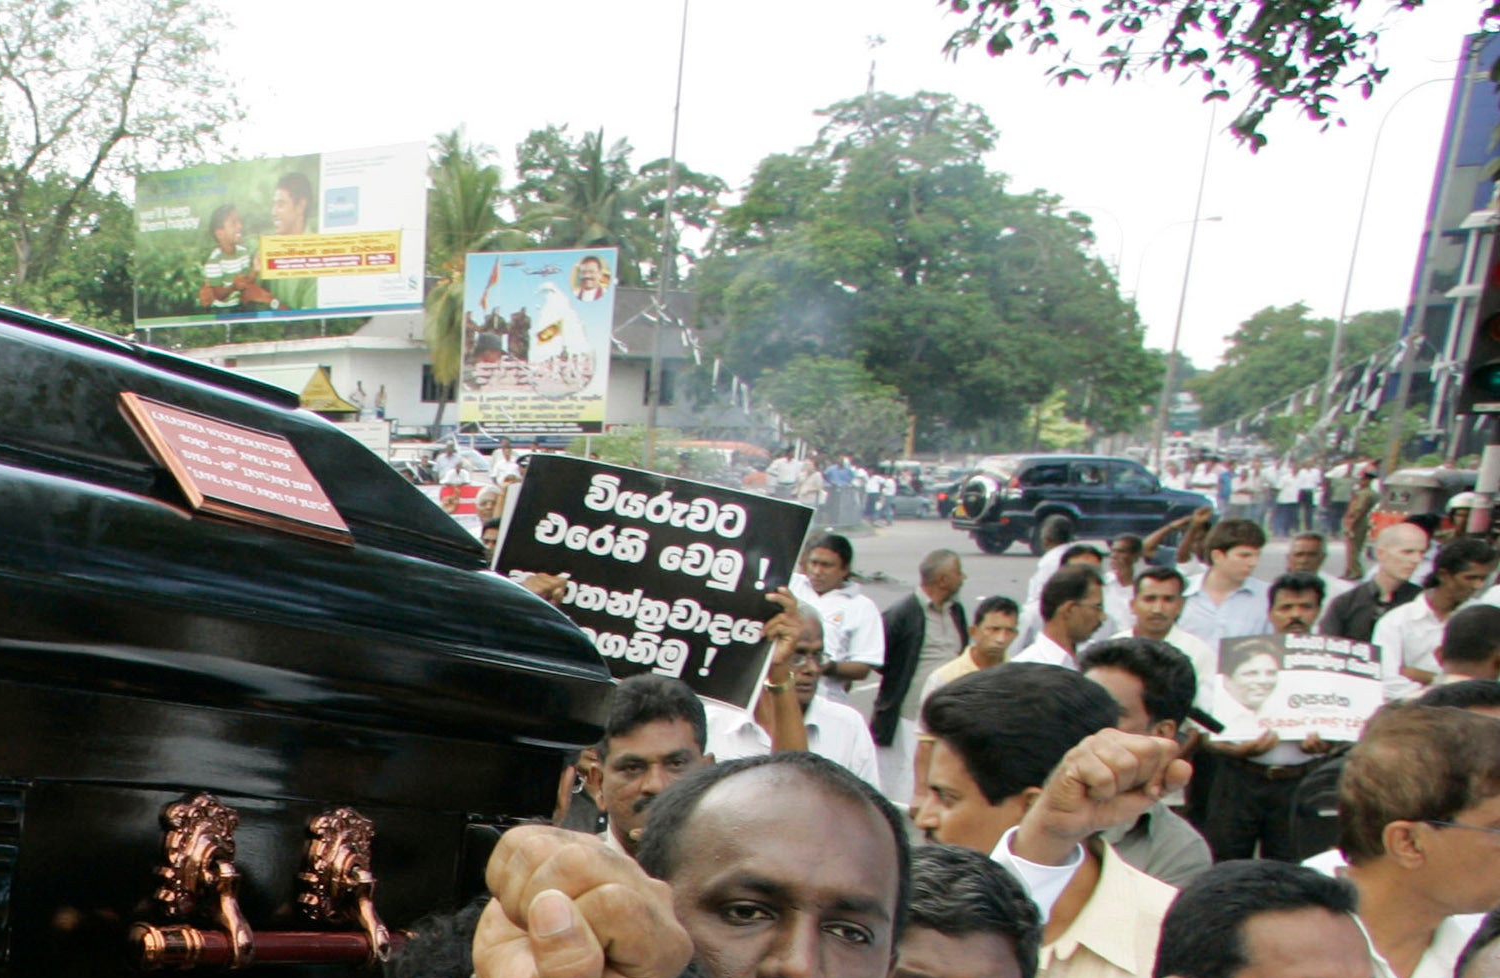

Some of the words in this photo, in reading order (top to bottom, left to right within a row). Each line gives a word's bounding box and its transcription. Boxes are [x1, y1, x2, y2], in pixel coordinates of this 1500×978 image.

[584, 473, 747, 539] වියරුවට
[534, 512, 650, 564] එරෙහි
[658, 542, 745, 592] වෙමු
[754, 557, 772, 590] !
[697, 646, 719, 677] !
